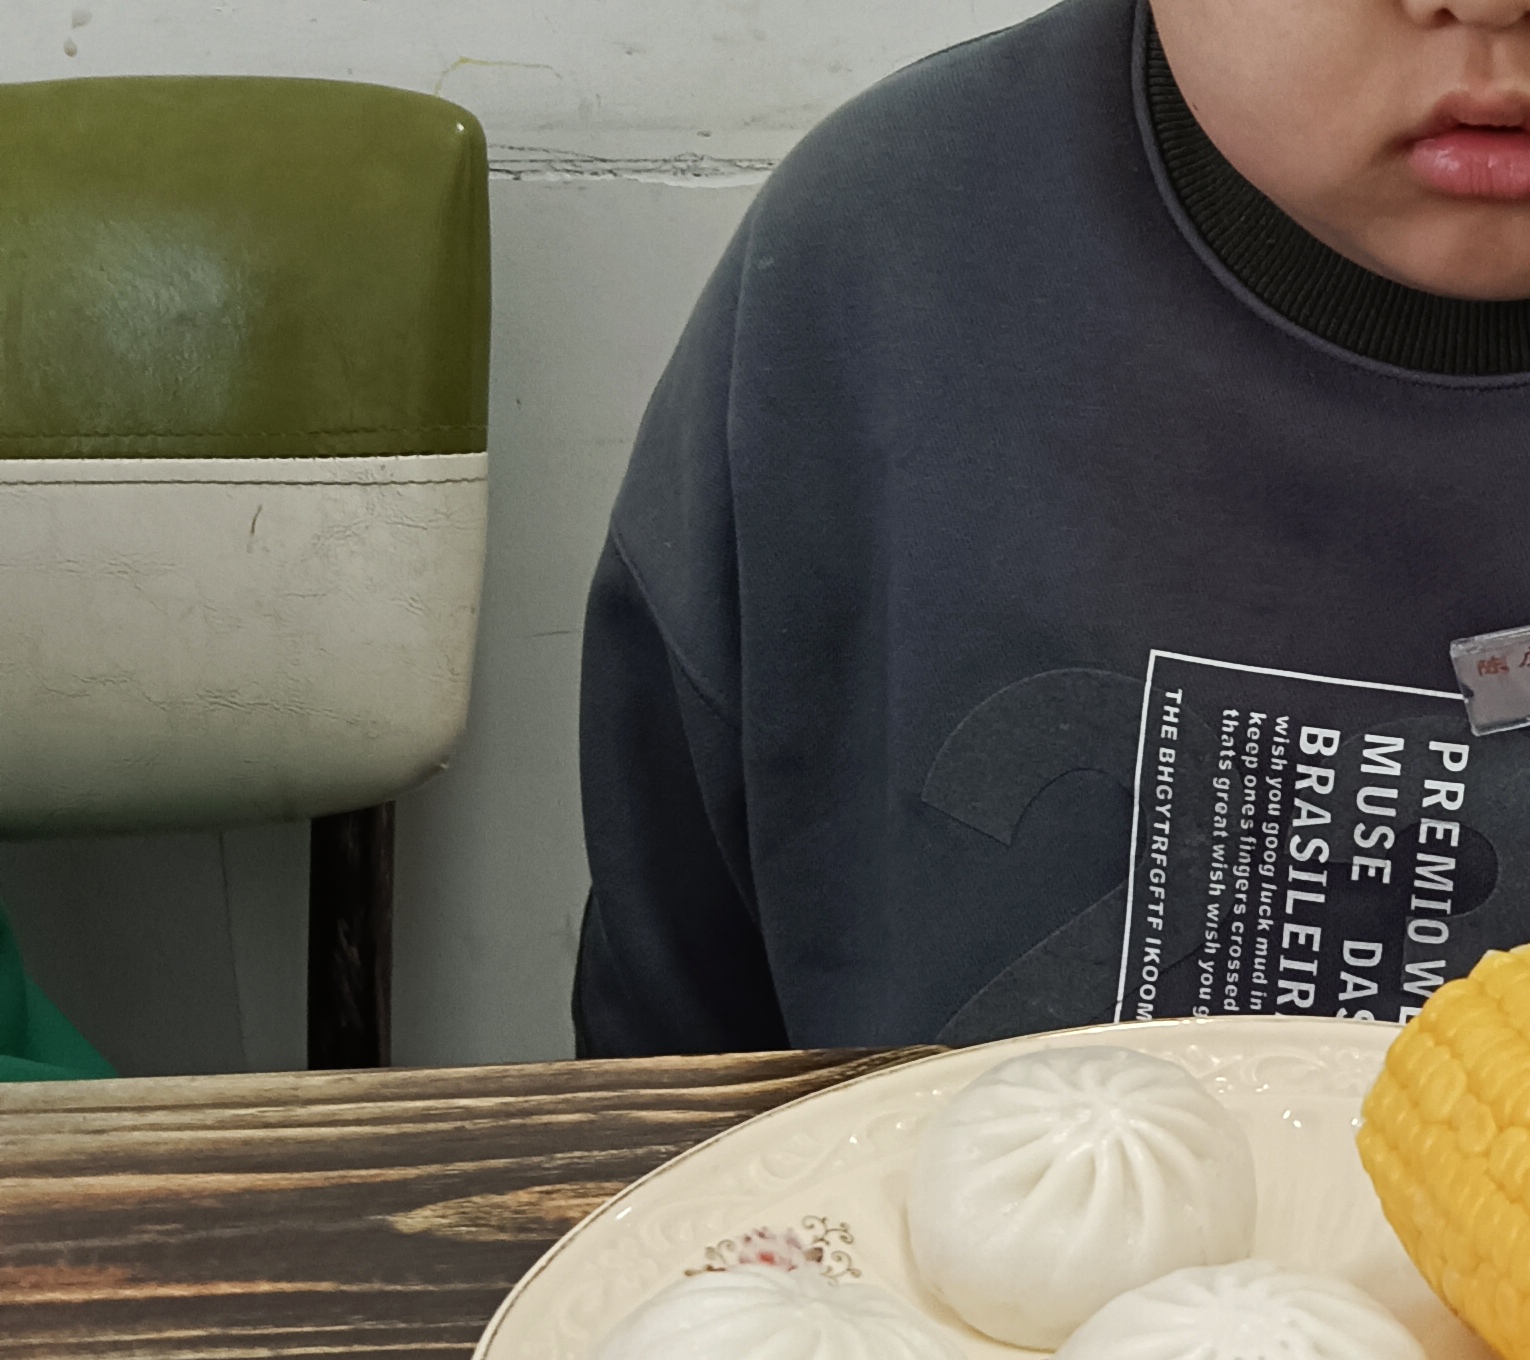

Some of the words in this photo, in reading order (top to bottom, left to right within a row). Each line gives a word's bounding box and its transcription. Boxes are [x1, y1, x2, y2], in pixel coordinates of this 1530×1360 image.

[1161, 689, 1182, 740] THE
[1218, 709, 1239, 770] thats
[1241, 712, 1267, 768] keep
[1271, 716, 1290, 770] wish
[1213, 778, 1230, 837] great
[1241, 775, 1256, 829] ones
[1266, 776, 1283, 815] you
[1351, 734, 1404, 883] MUSE
[1147, 747, 1175, 930] BHGYTRFGFTF
[1259, 822, 1279, 876] goog
[1408, 741, 1469, 944] PREMIO
[1209, 845, 1228, 895] wish
[1233, 837, 1256, 914] fingers
[1275, 726, 1341, 1015] BRASILEIR
[1205, 904, 1222, 953] wish
[1258, 883, 1277, 930] luck
[1198, 960, 1214, 999] you
[1224, 922, 1244, 1011] crossed
[1252, 938, 1269, 984] mud
